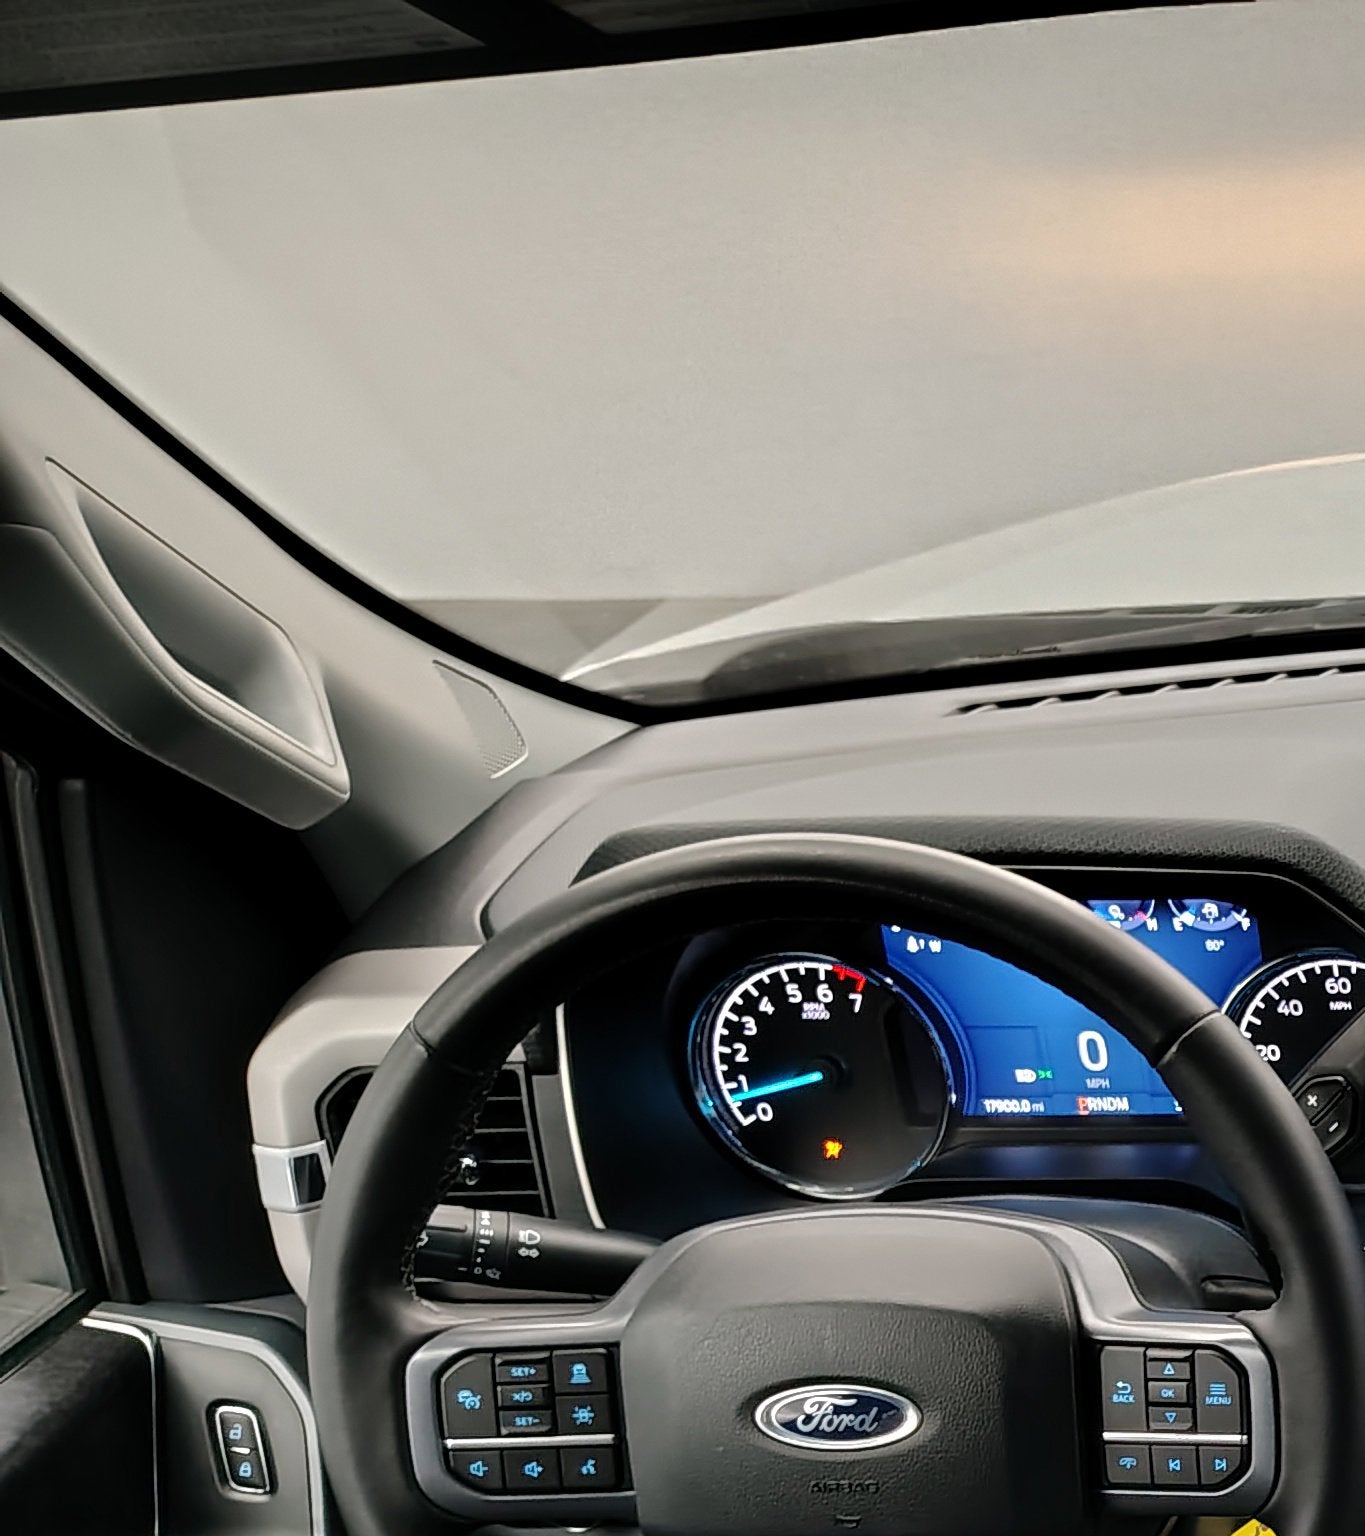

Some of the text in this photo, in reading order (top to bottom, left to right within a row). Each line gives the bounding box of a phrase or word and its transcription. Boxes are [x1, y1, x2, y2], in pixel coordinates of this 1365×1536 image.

[785, 983, 802, 1003] 5
[816, 983, 833, 1003] 6
[1324, 976, 1352, 994] 60
[758, 996, 775, 1015] 4
[848, 993, 862, 1013] 7
[1276, 998, 1303, 1016] 40
[1328, 1000, 1352, 1011] MPH
[740, 1015, 757, 1035] 3
[732, 1042, 749, 1062] 2
[1077, 1030, 1109, 1072] 0
[737, 1074, 749, 1093] 1
[1085, 1077, 1110, 1089] MPH
[756, 1101, 773, 1122] 0
[1112, 1393, 1135, 1403] BACK
[1161, 1388, 1175, 1398] OK
[1205, 1396, 1232, 1405] MENU
[796, 1396, 879, 1433] Ford
[808, 1479, 881, 1495] AIRBAG
